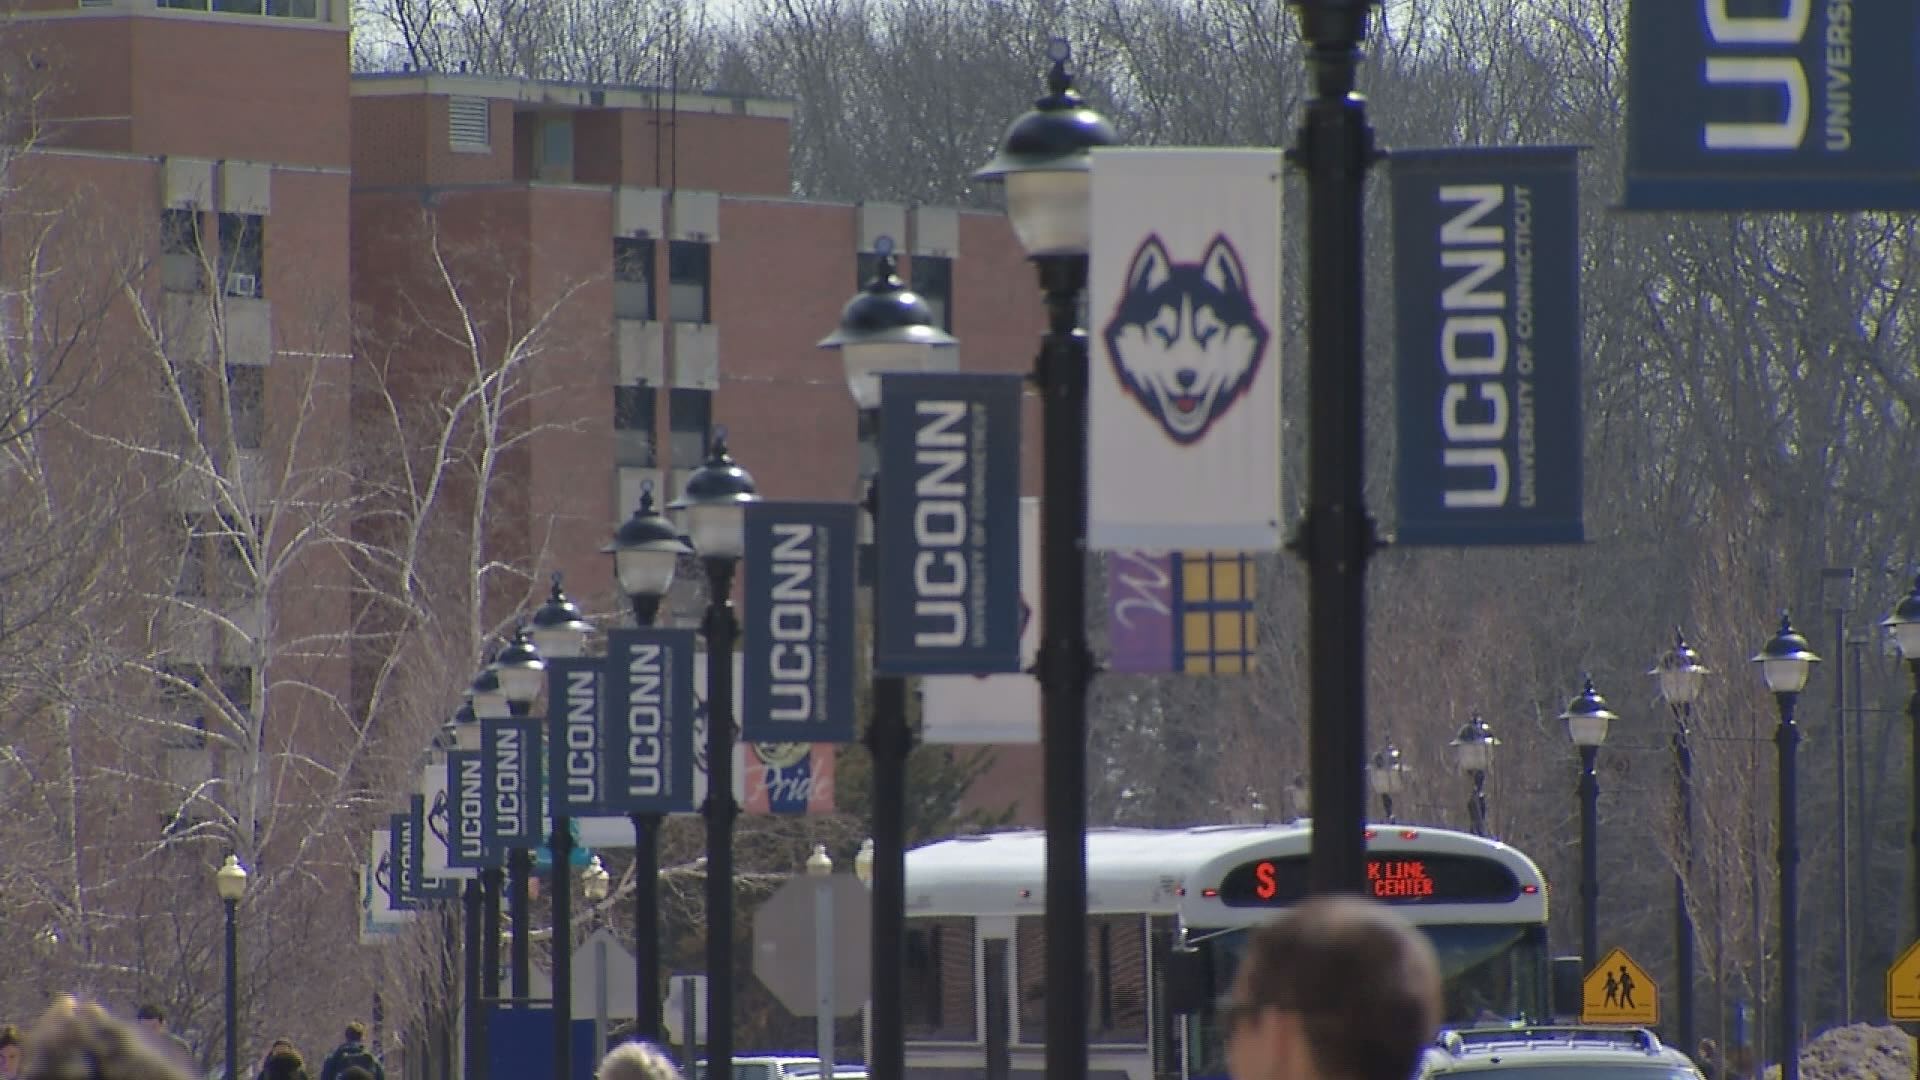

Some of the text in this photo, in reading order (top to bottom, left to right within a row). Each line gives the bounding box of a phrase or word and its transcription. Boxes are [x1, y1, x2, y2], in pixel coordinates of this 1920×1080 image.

[1439, 184, 1510, 508] UCONN
[1514, 185, 1536, 508] UNIVERSITY OF CONNECTICUT
[914, 400, 968, 648] UCONN
[769, 523, 813, 721] UCONN
[566, 671, 595, 803] UCONN
[629, 644, 661, 796] UCONN
[461, 760, 482, 858] UCONN
[496, 728, 519, 836] UCONN
[744, 757, 834, 804] Pride
[1255, 861, 1276, 899] S
[1374, 878, 1433, 897] CENTER
[1385, 861, 1427, 879] LINE
